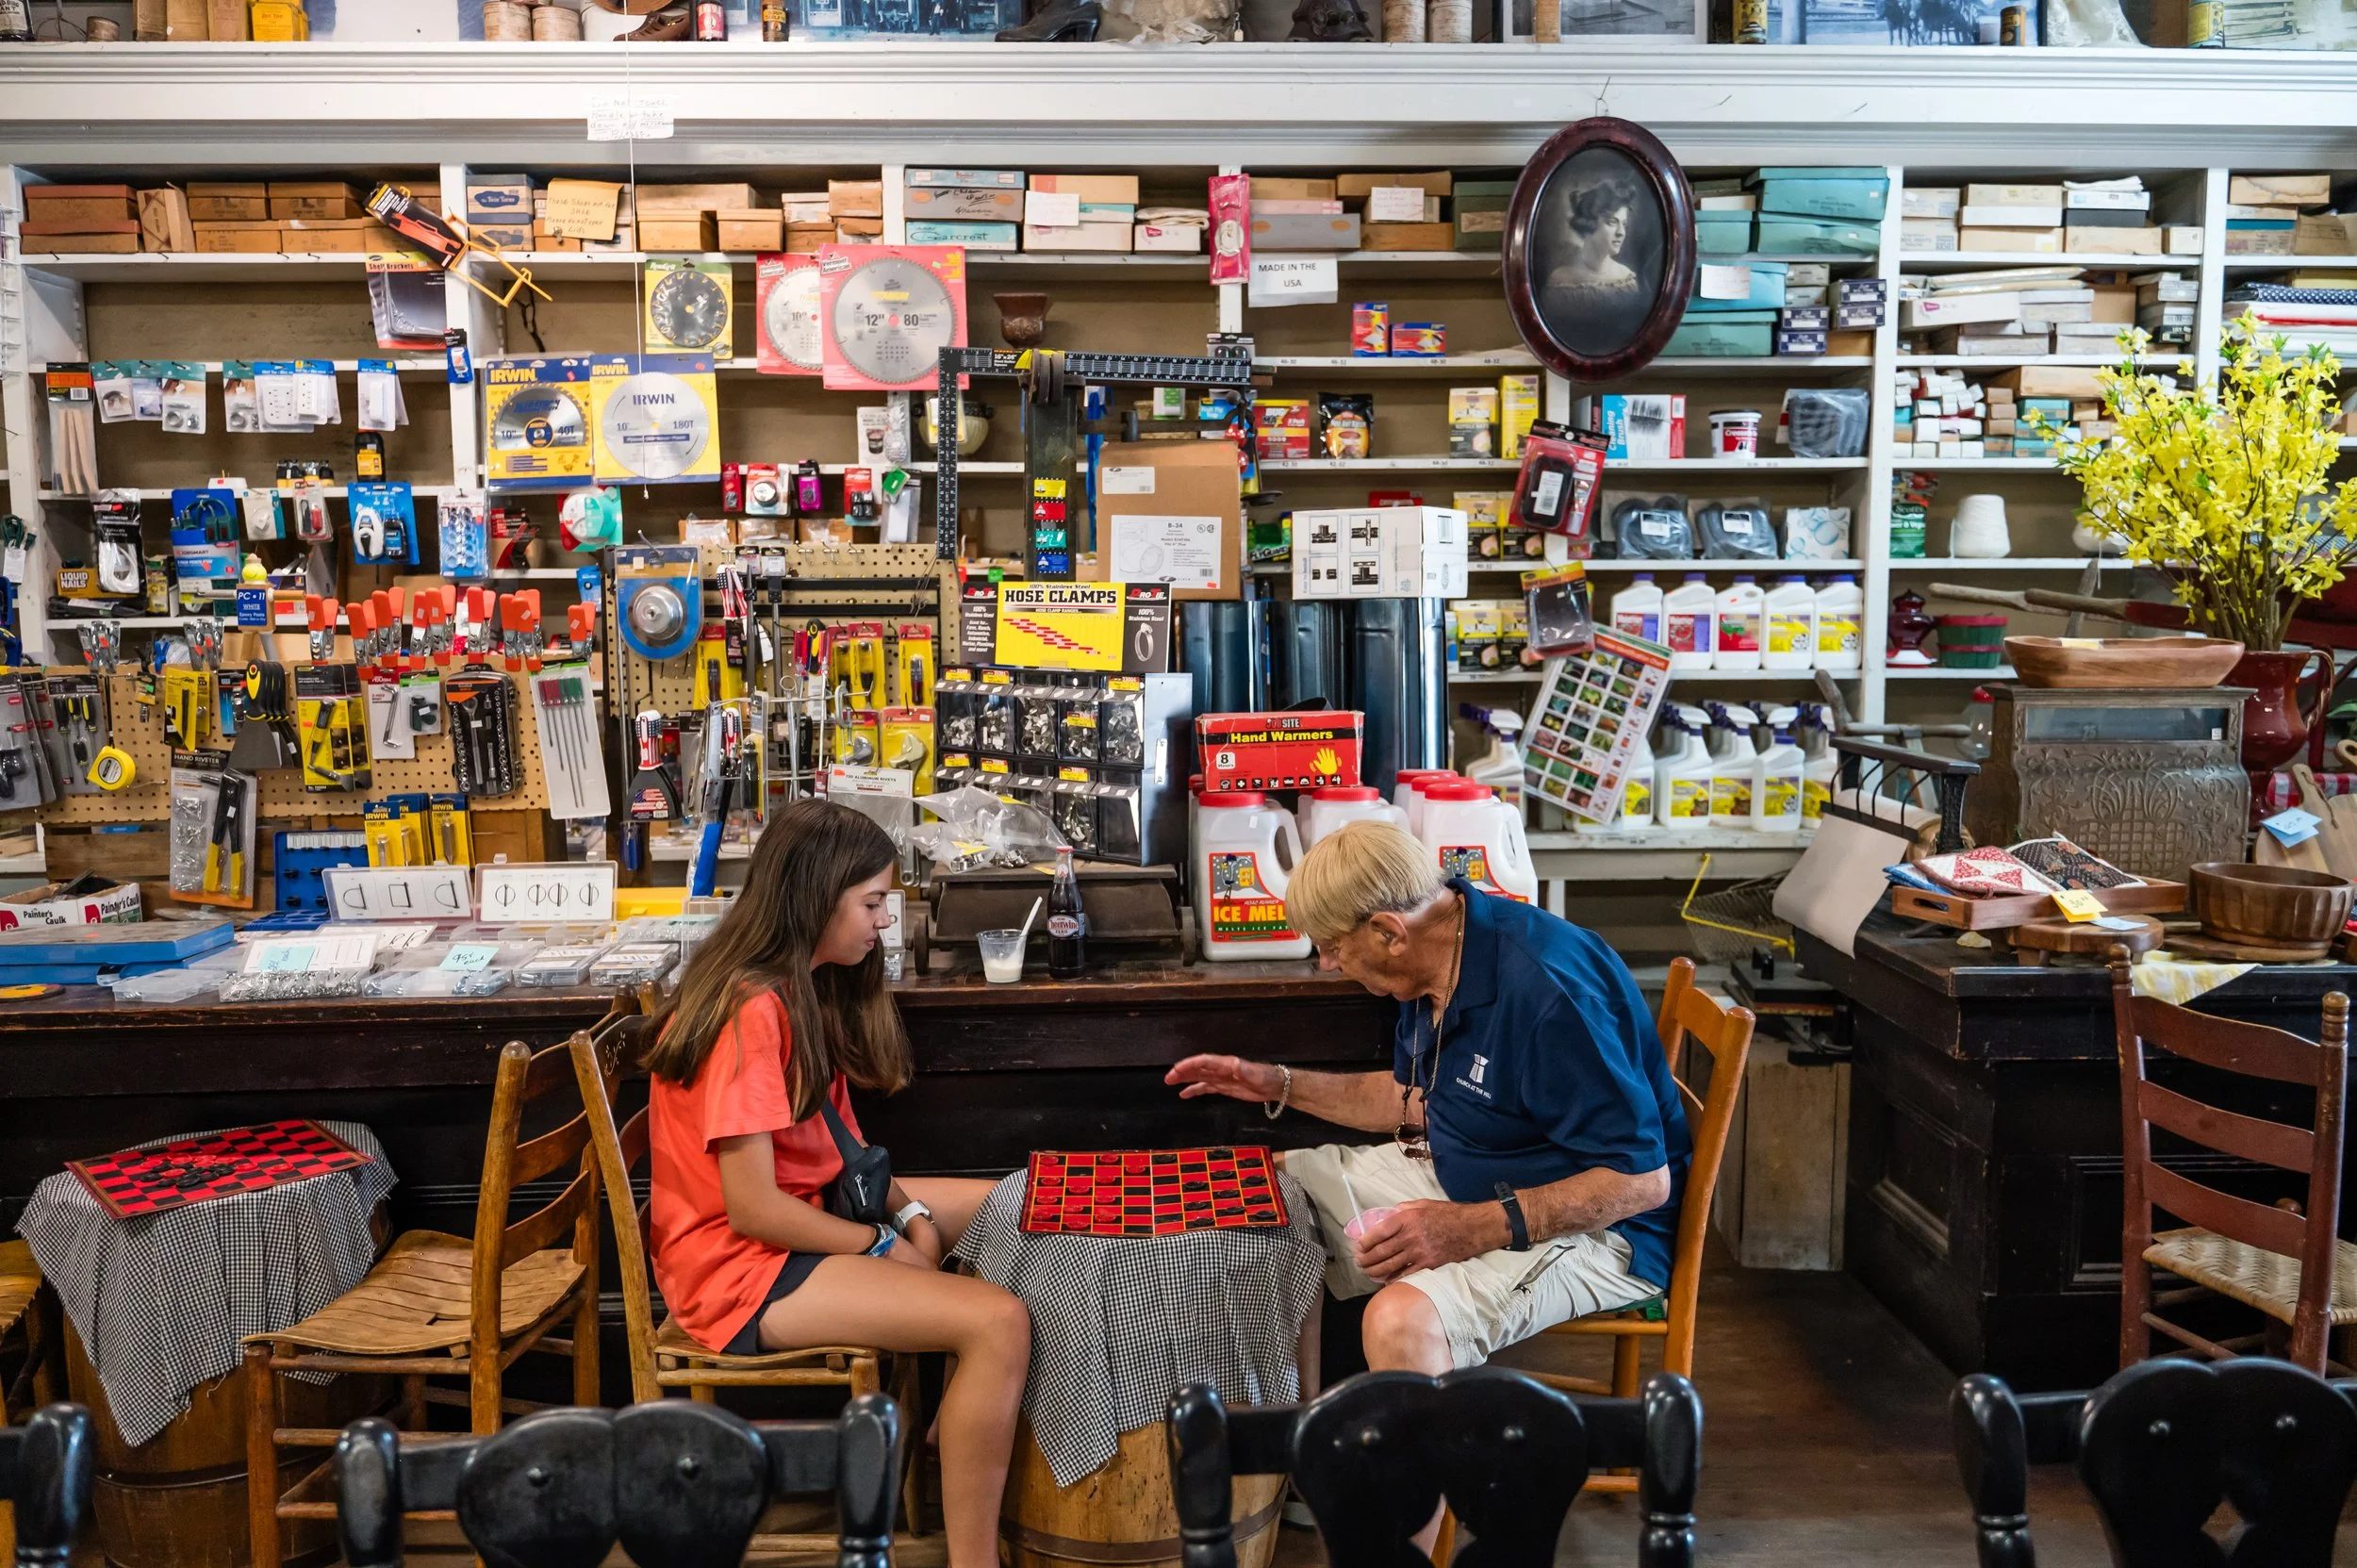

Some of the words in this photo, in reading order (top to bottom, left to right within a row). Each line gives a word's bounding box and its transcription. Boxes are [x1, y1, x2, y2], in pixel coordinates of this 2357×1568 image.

[1283, 279, 1302, 288] USA
[904, 314, 918, 326] 80
[592, 364, 629, 375] IRWIN
[490, 369, 537, 383] IRWIN
[633, 393, 675, 405] IRWIN
[1607, 410, 1617, 452] Cleaning
[1617, 419, 1625, 446] Brush
[59, 571, 89, 581] LIQUID
[60, 579, 87, 588] NAILS
[238, 591, 251, 601] PC
[1004, 589, 1044, 603] HOSE
[1048, 589, 1116, 604] CLAMPS
[1230, 732, 1267, 743] Hand
[1271, 730, 1333, 742] Warmers
[194, 755, 220, 764] RIVETER
[1220, 753, 1228, 764] 8
[24, 910, 53, 918] Painter's
[1213, 906, 1241, 922] ICE
[1248, 905, 1286, 921] MEL
[1456, 1077, 1471, 1089] CHURCH
